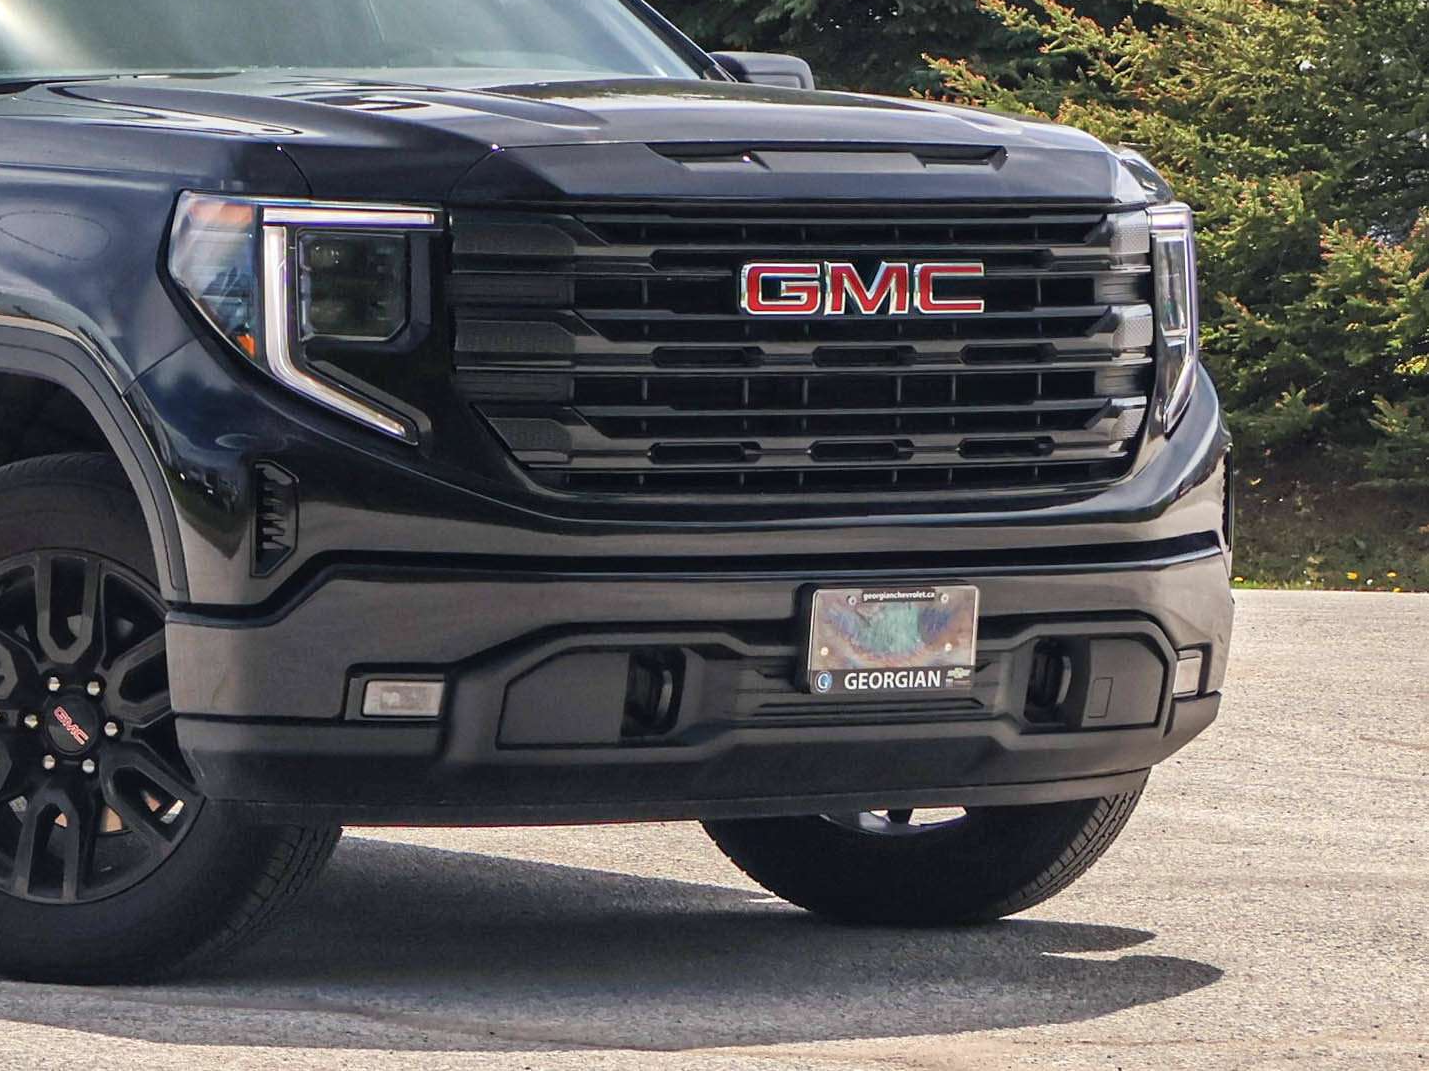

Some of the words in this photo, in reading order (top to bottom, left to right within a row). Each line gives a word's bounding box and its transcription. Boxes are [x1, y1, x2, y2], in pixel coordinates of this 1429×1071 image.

[741, 261, 985, 315] GMC
[862, 591, 936, 602] georgianchevrolet.ca
[844, 670, 941, 690] GEORGIAN
[53, 706, 90, 745] GMC
